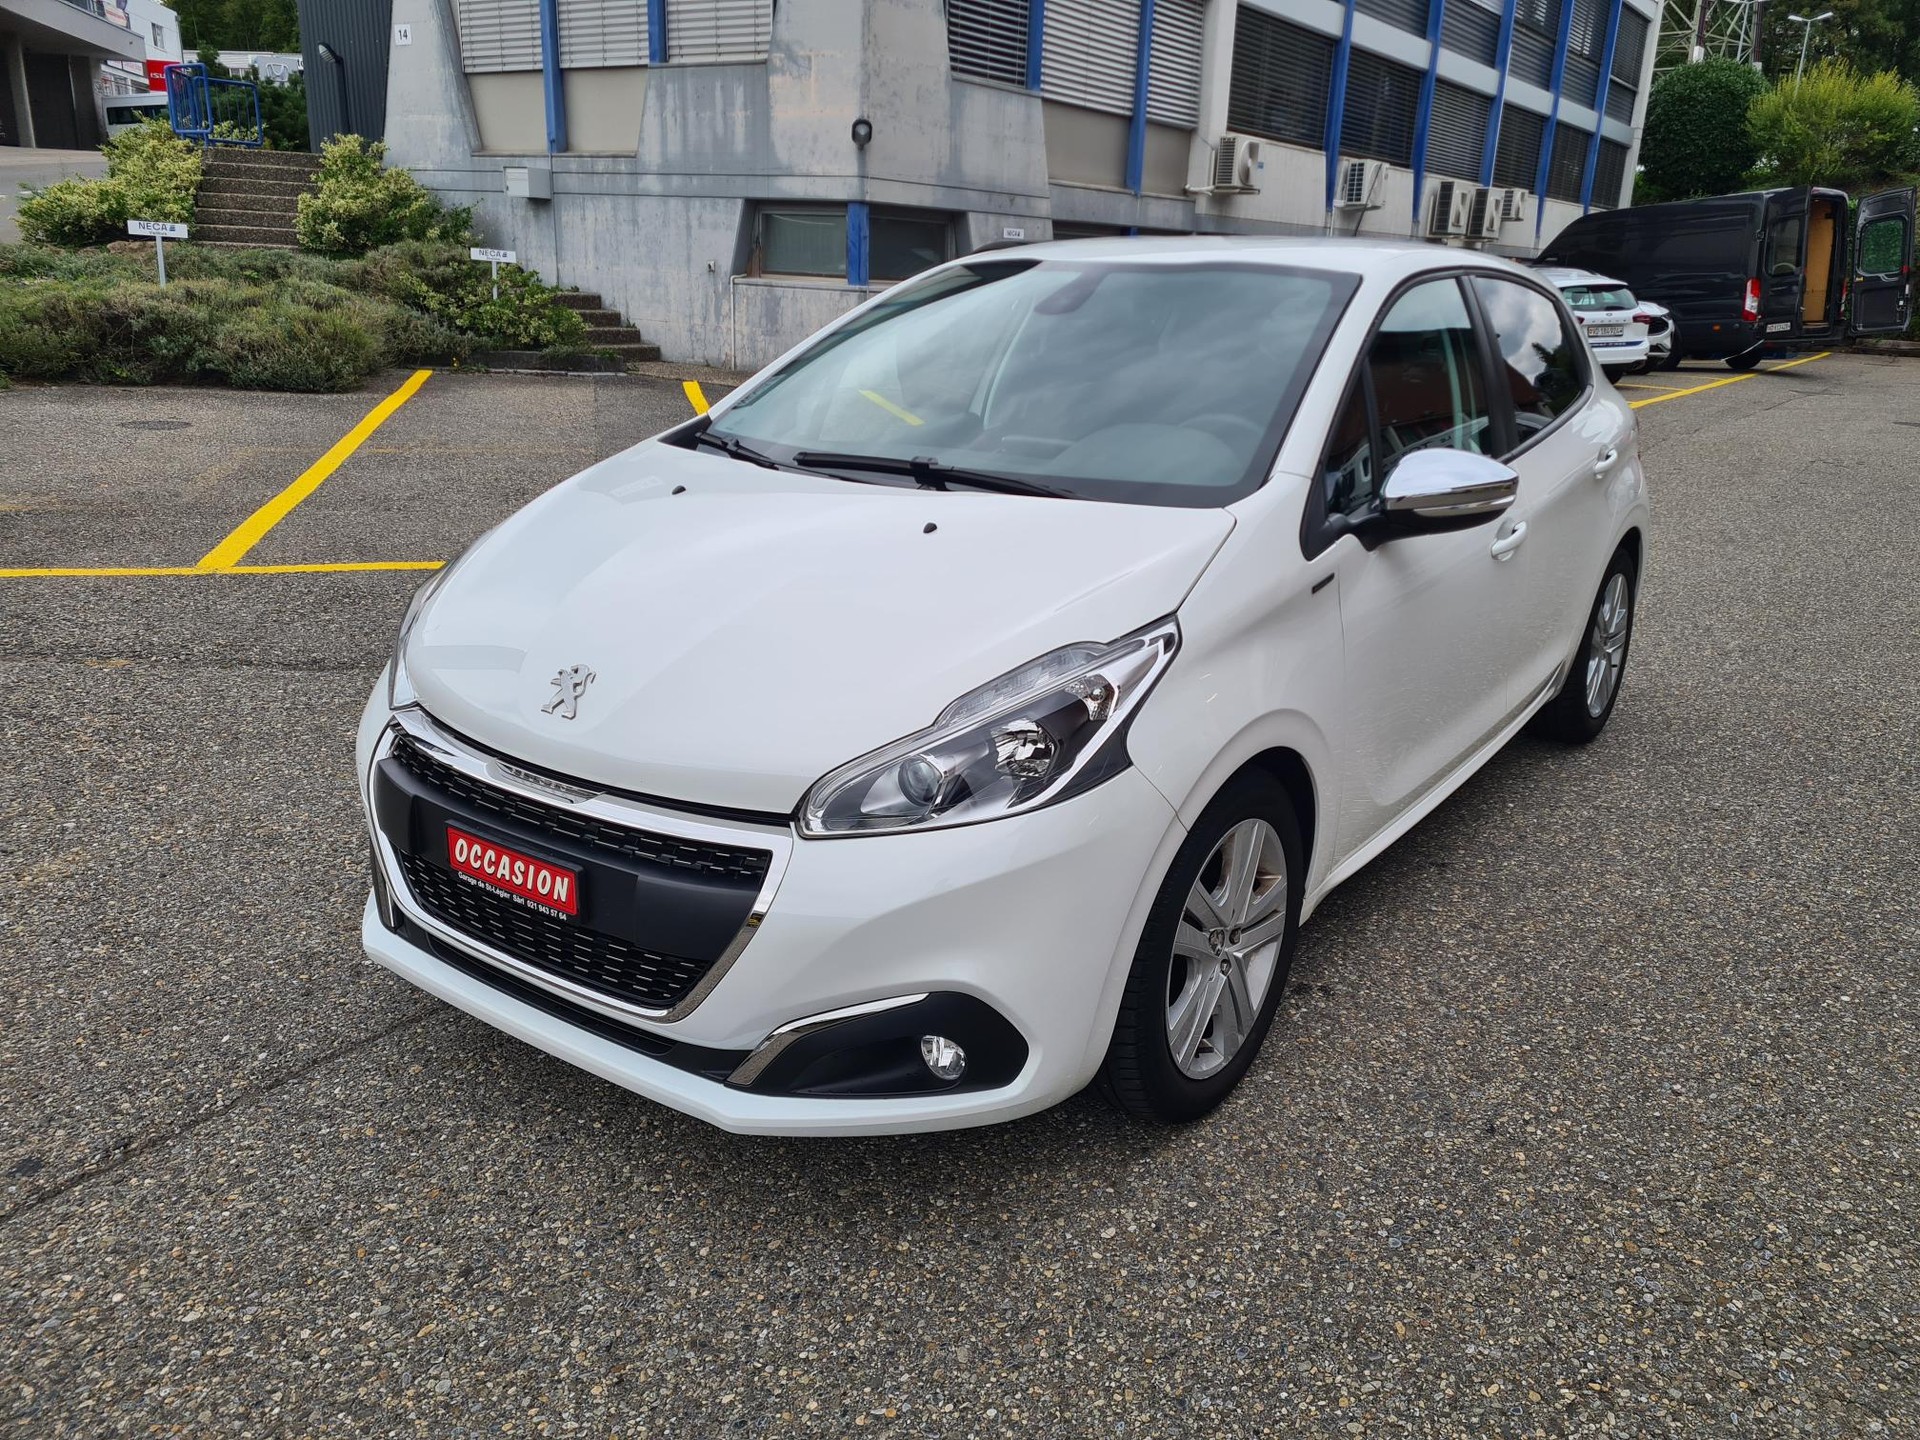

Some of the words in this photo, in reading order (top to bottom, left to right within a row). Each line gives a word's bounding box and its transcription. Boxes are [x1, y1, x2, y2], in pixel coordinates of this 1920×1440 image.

[399, 29, 408, 40] 14
[138, 221, 168, 231] NECA
[479, 249, 501, 258] NECA
[455, 838, 569, 902] OCCASION
[458, 871, 477, 886] Garage
[477, 880, 485, 889] de
[527, 900, 538, 910] 021
[538, 904, 549, 915] 943
[550, 908, 558, 918] 57
